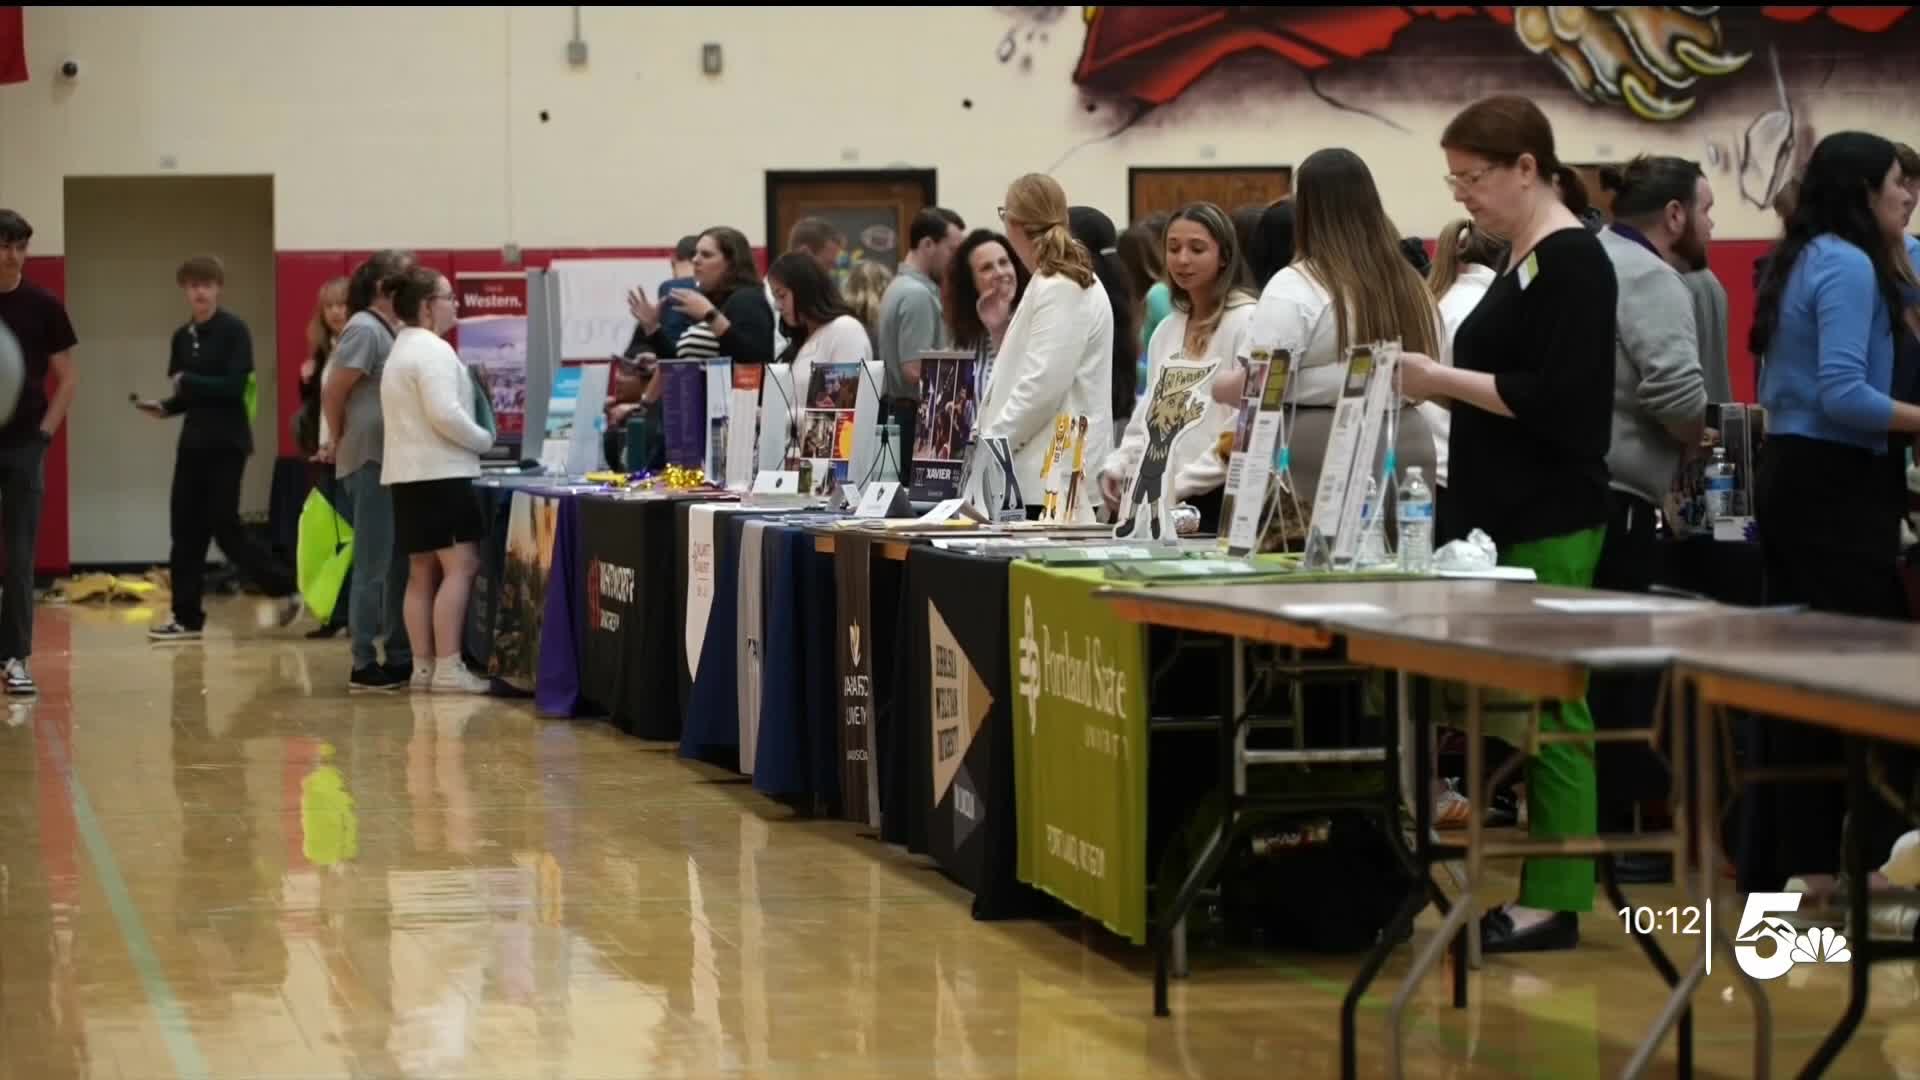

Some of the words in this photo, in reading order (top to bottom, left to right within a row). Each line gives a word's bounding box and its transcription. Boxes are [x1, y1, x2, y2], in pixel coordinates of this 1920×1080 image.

[464, 293, 522, 308] Western.
[926, 468, 951, 480] XAVIER
[1042, 624, 1093, 707] Portland
[1093, 636, 1127, 719] State
